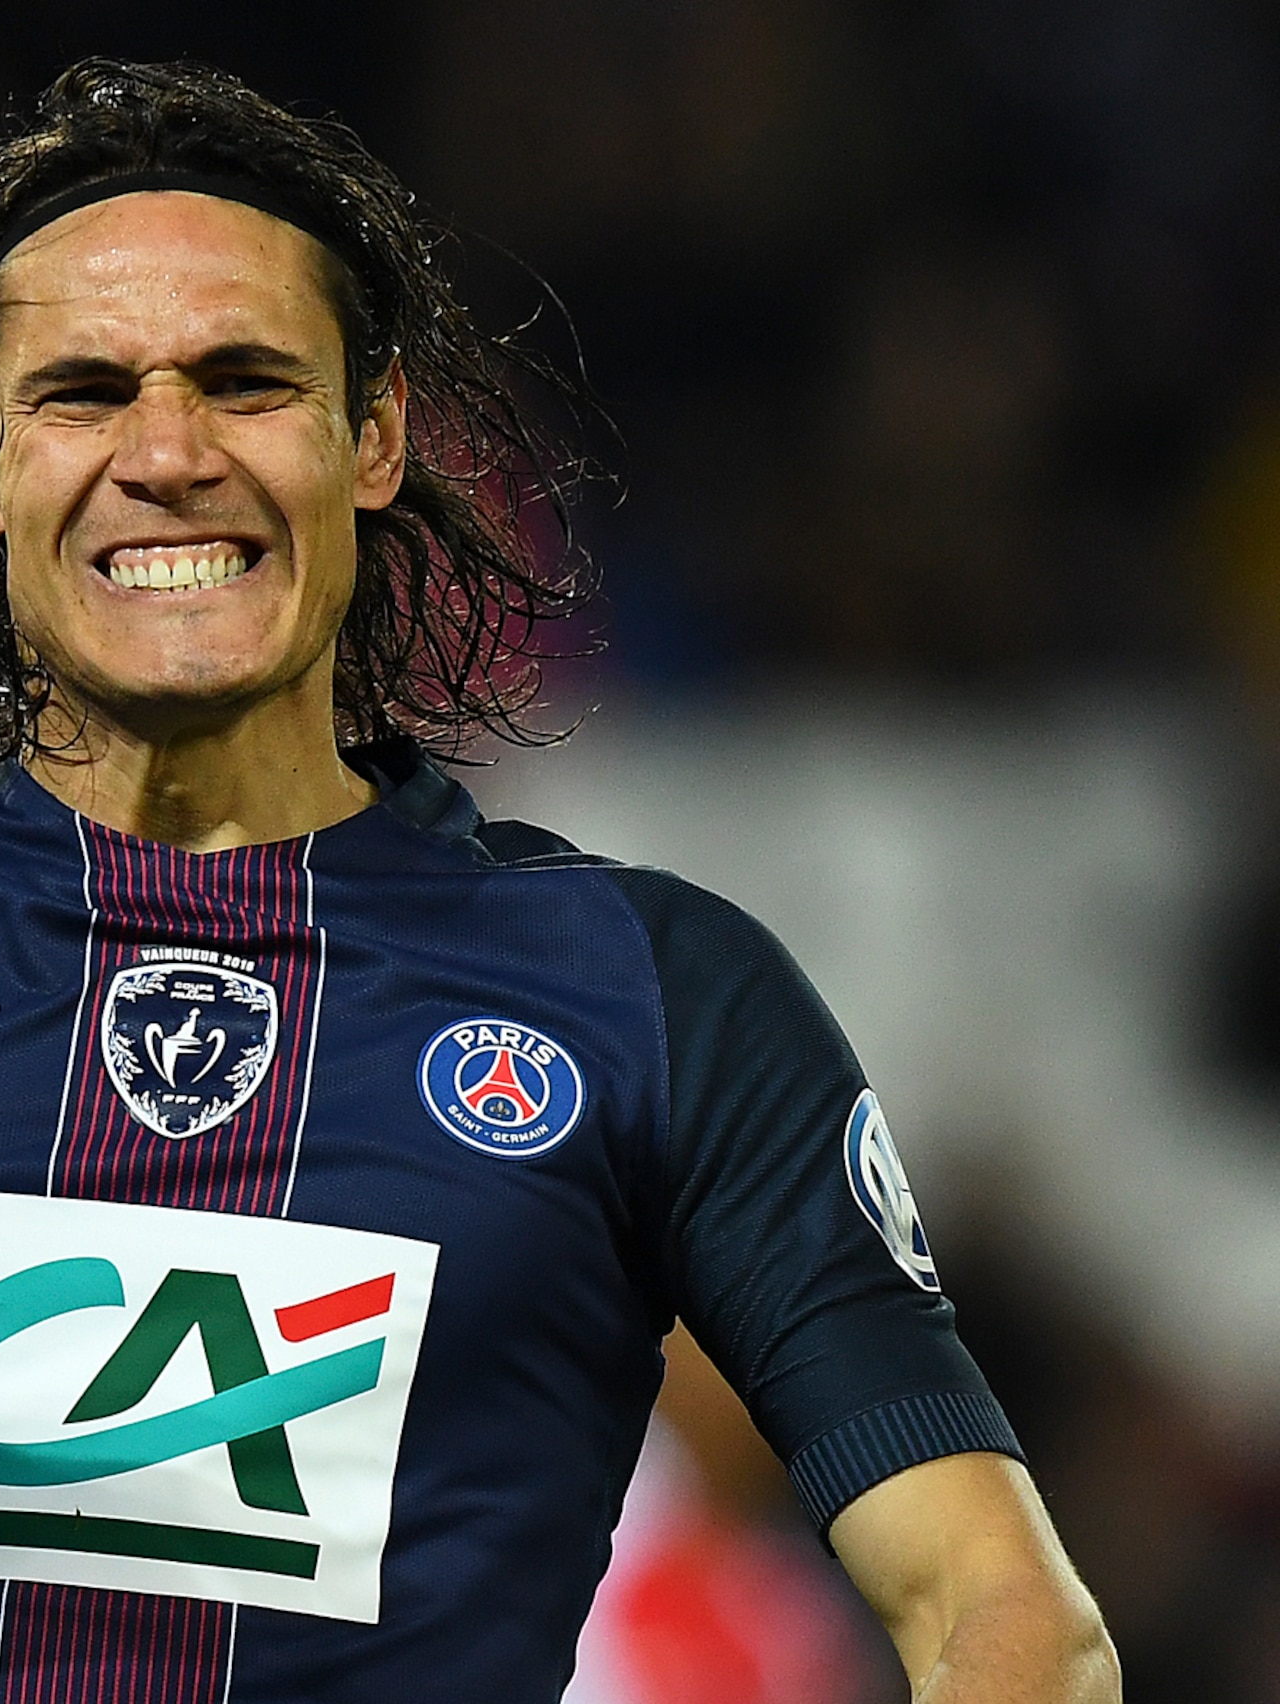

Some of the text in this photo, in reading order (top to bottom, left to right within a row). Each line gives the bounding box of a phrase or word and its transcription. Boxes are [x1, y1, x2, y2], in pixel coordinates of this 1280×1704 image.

[141, 948, 219, 963] VAINQUEUR
[452, 1025, 558, 1066] PARIS
[447, 1104, 483, 1134] SAINT
[491, 1123, 549, 1143] GERMAIN
